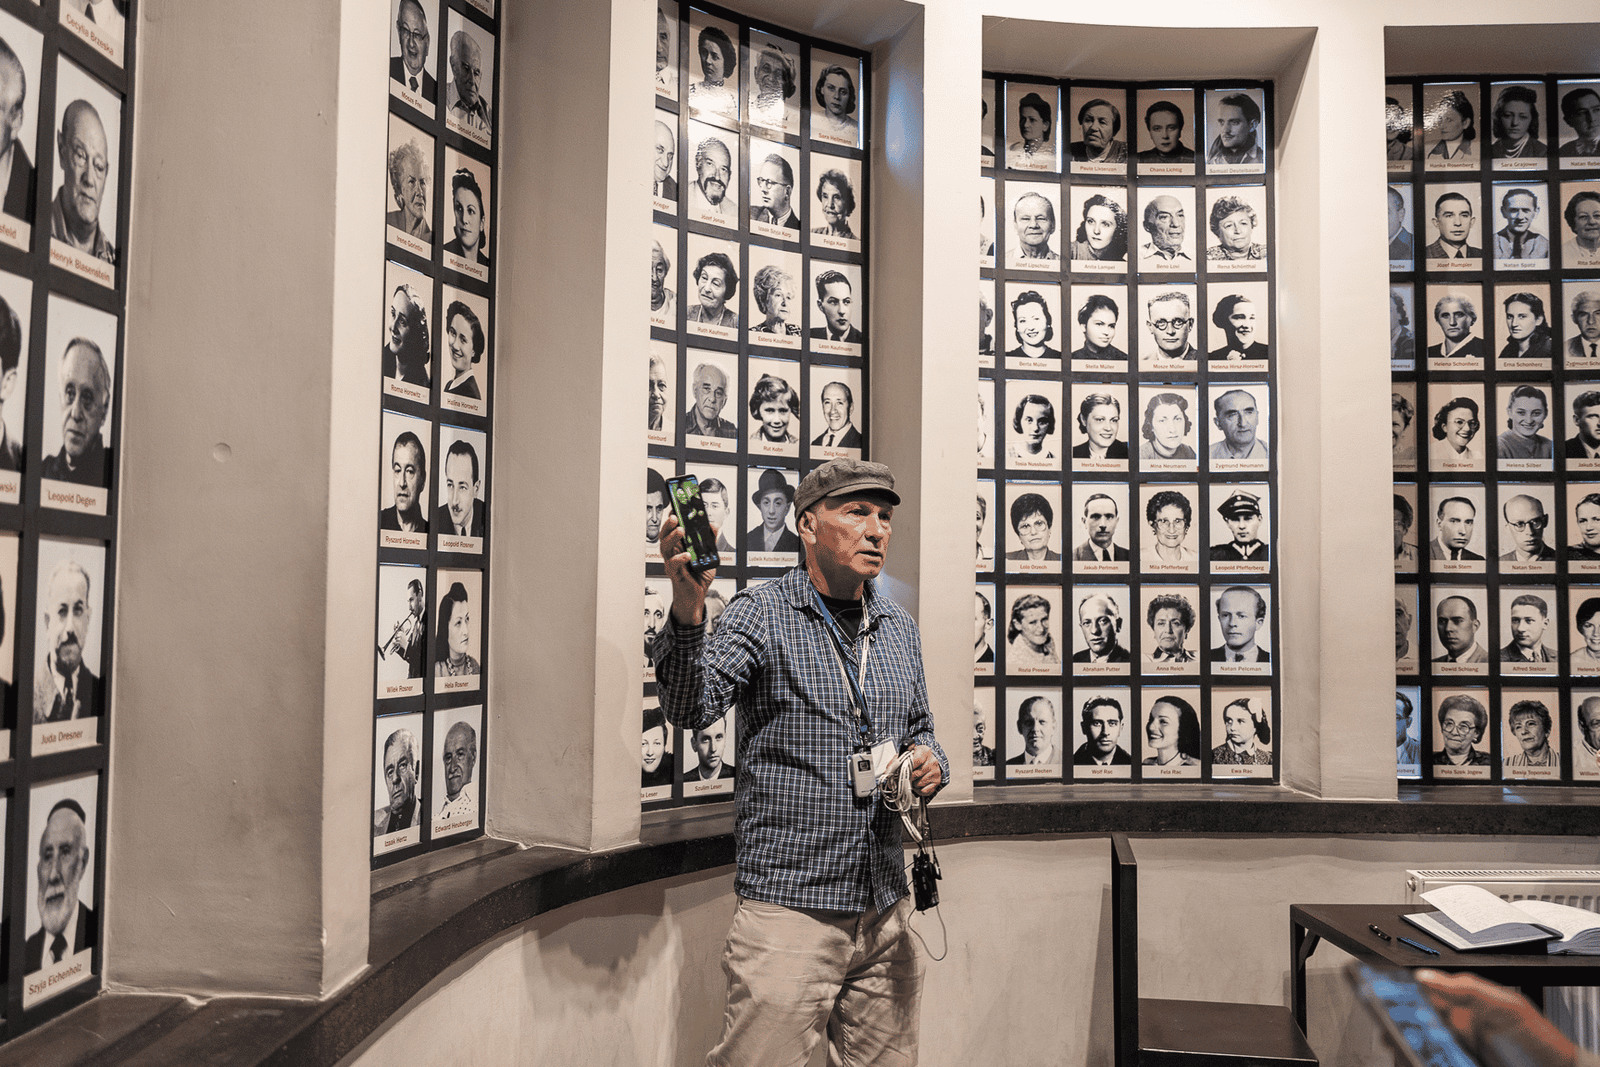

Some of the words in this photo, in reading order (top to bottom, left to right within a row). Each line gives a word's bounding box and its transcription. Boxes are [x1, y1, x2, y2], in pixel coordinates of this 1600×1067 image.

[50, 248, 74, 267] Henryk
[0, 482, 17, 494] wski
[47, 490, 75, 504] Leopold
[75, 494, 97, 508] Degen
[41, 733, 57, 745] Juda
[58, 730, 84, 742] Dresner
[48, 962, 83, 986] Eichenholz
